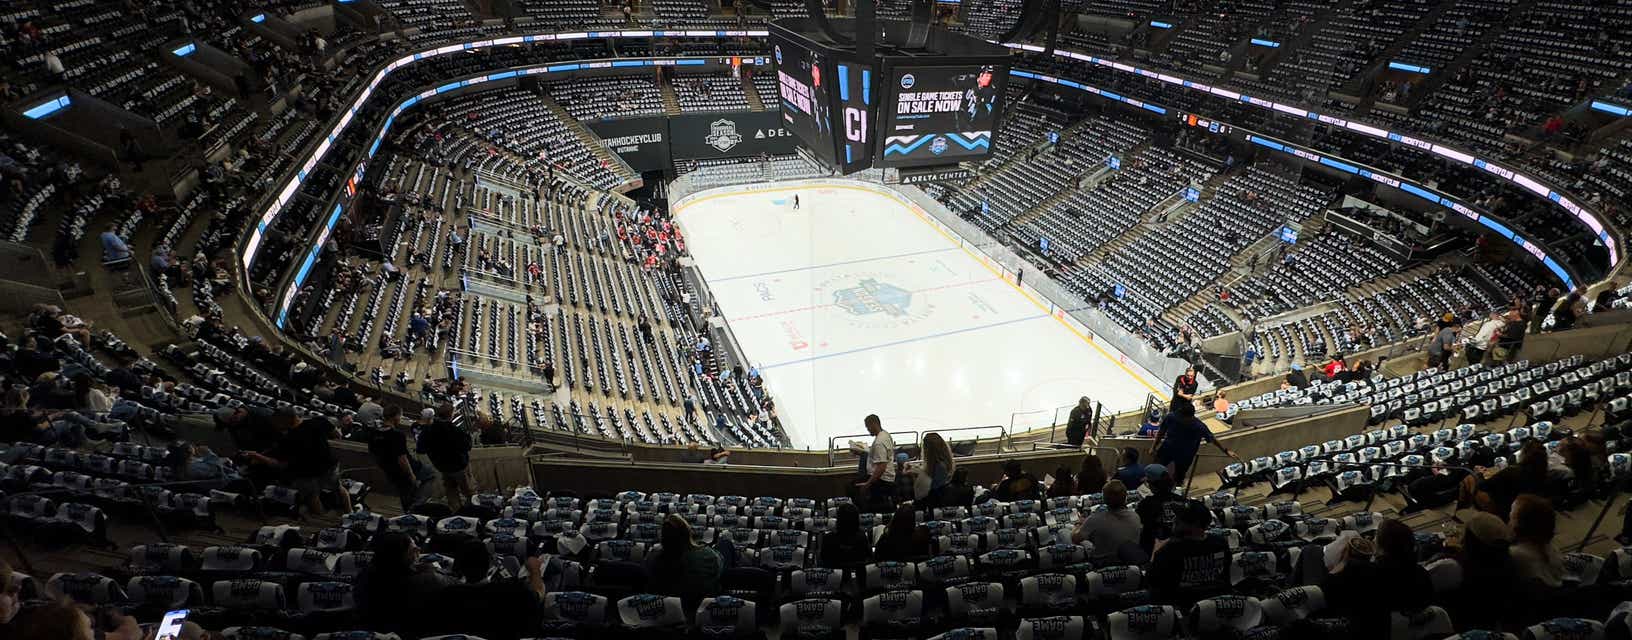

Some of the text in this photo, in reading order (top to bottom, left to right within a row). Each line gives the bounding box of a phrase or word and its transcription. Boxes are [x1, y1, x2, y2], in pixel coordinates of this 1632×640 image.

[921, 92, 939, 101] GAME
[939, 91, 963, 100] TICKETS
[897, 100, 962, 114] ON SALE NOW
[911, 172, 967, 182] DELTA CENTER
